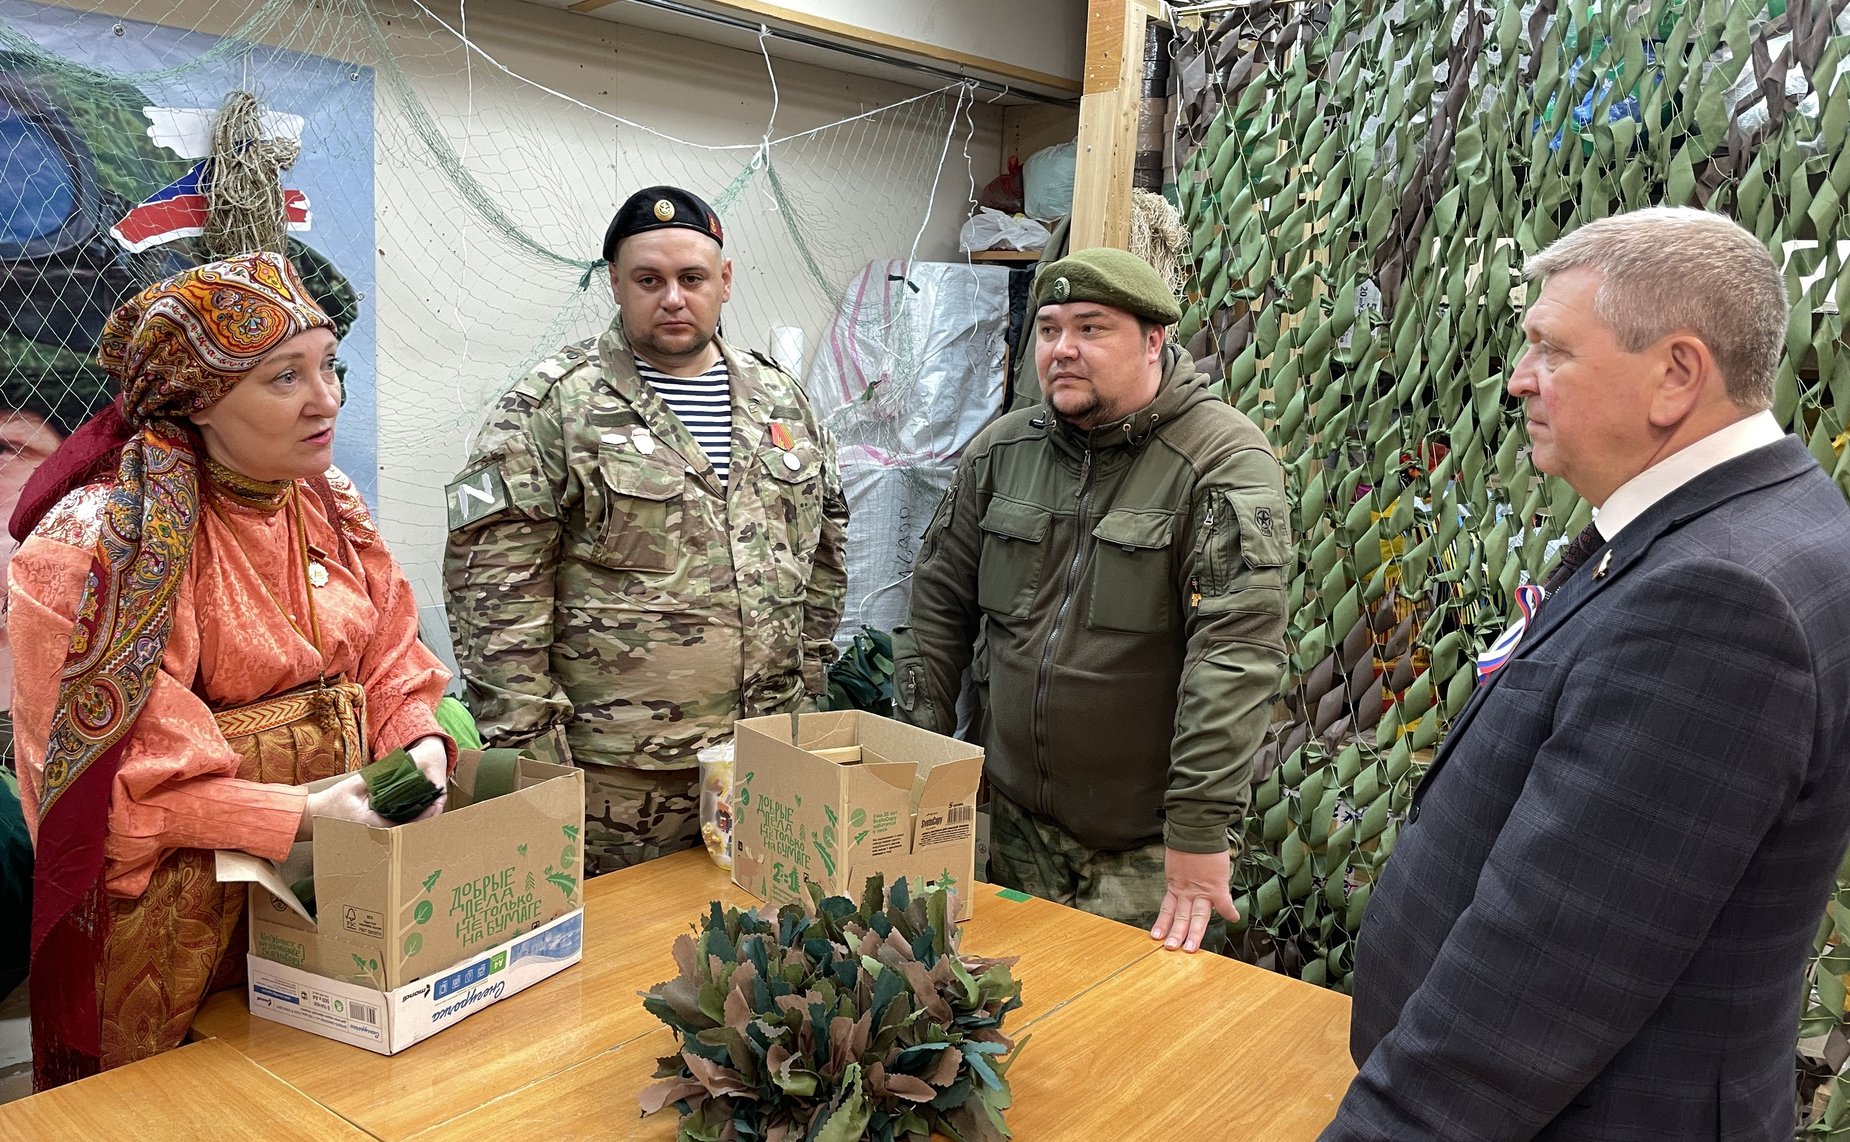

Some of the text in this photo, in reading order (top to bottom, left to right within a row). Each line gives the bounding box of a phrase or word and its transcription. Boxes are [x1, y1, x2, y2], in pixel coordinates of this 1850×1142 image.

[458, 472, 495, 520] N
[757, 794, 793, 823] ДОБРЫЕ
[765, 811, 793, 836] ДЕЛА
[760, 822, 805, 852] НЕ ТОЛЬКО
[763, 837, 811, 870] НА БУМАГЕ
[449, 866, 516, 917] ДОБРЫЕ
[464, 886, 514, 924] ДЕЛА
[456, 892, 533, 938] НЕ ТОЛЬКО
[462, 900, 542, 948] НА БУМАГЕ
[402, 988, 427, 1003] mondi
[431, 980, 505, 1022] Снегурочка
